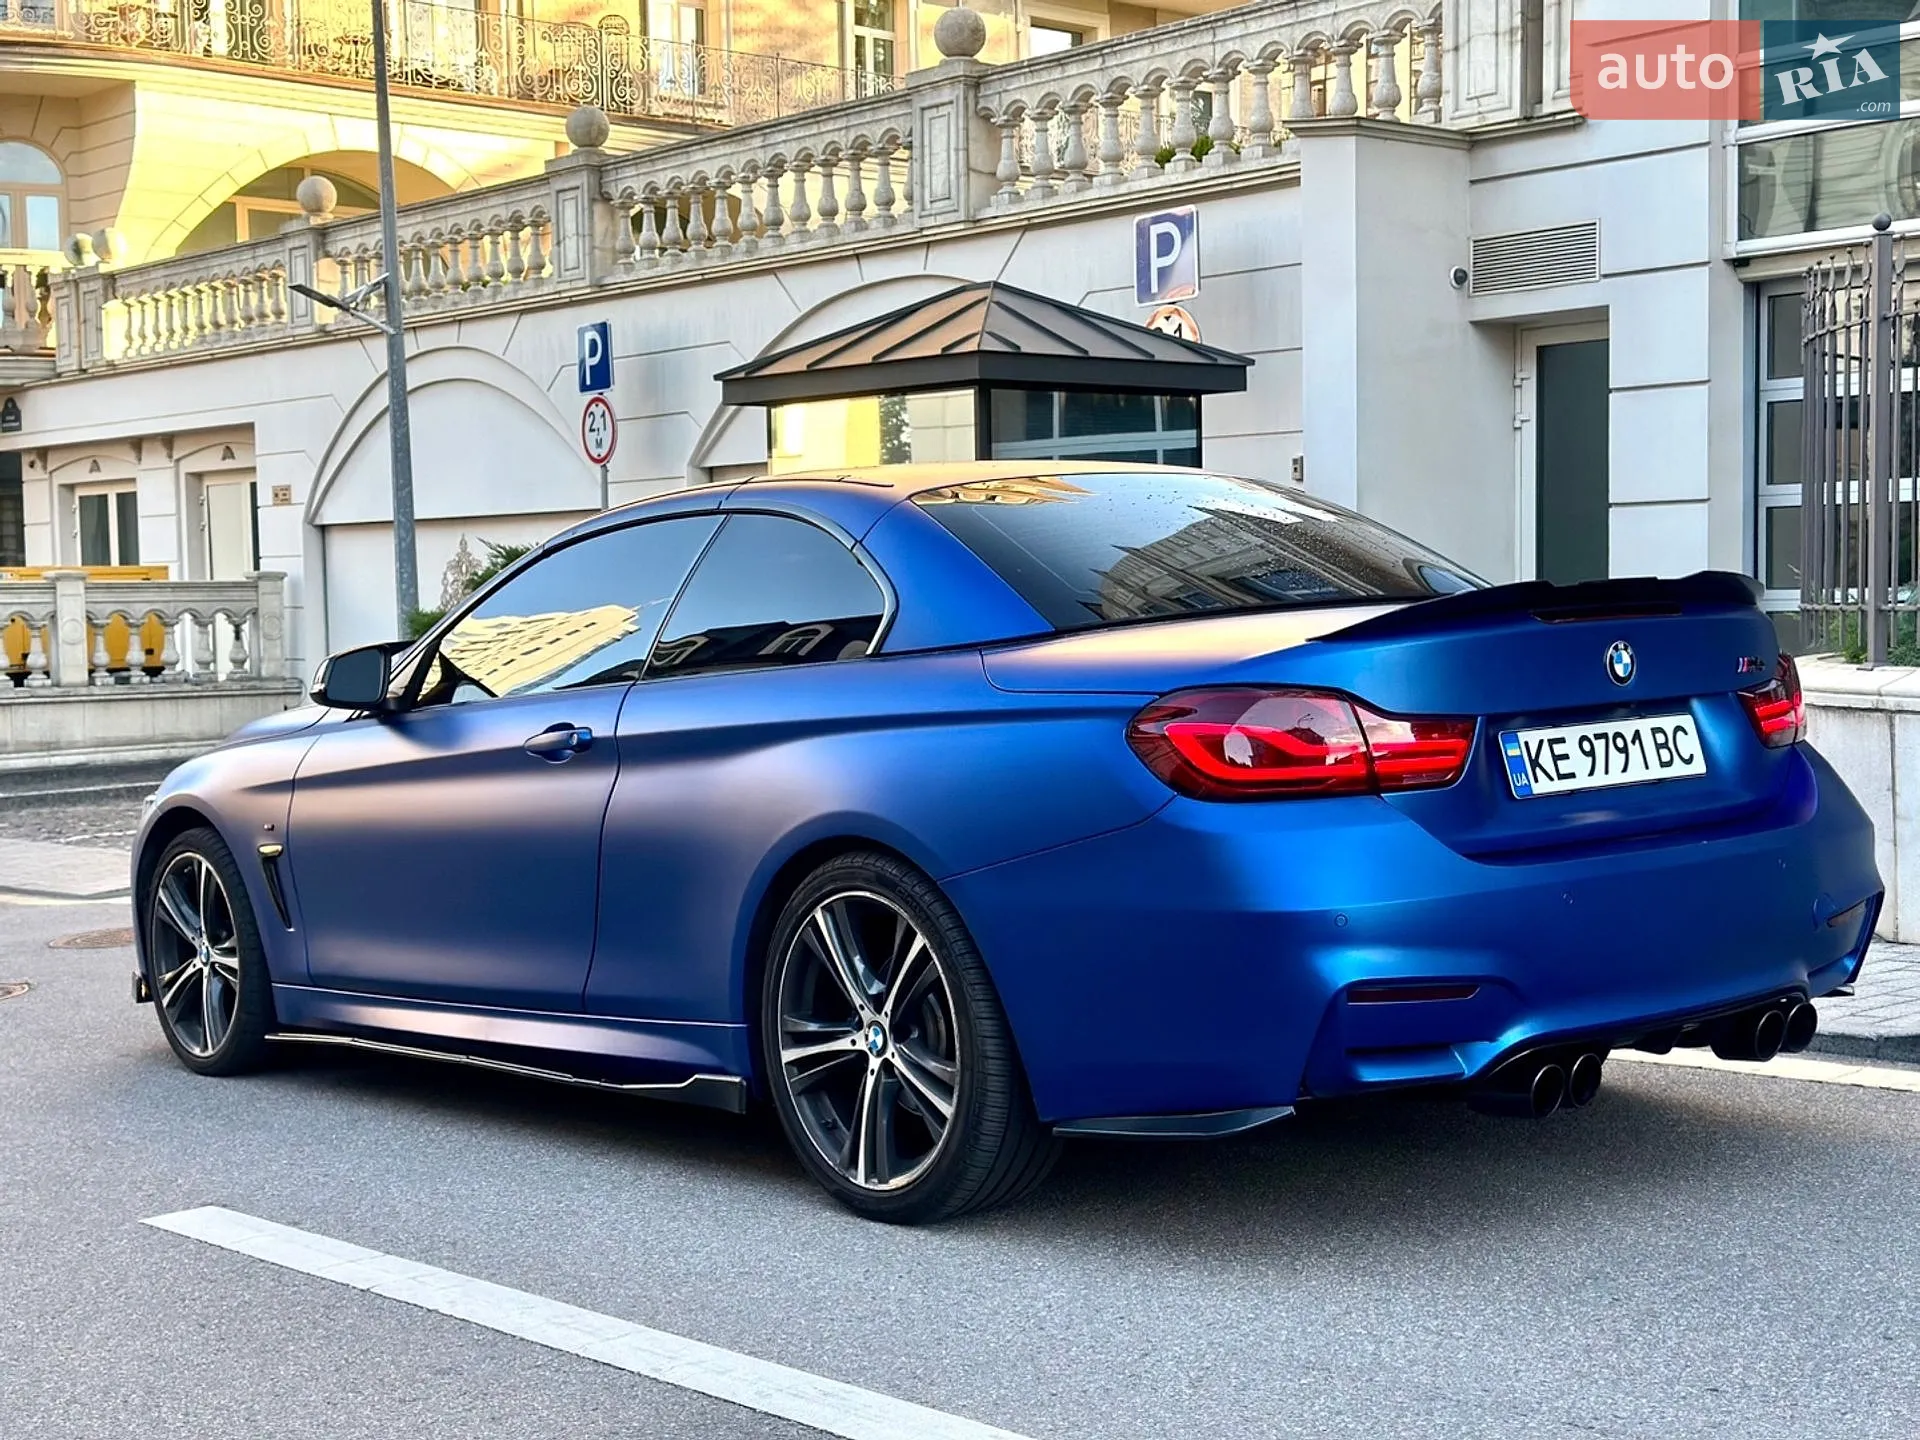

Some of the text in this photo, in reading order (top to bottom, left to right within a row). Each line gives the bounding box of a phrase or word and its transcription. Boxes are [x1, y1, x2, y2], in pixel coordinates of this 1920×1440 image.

[1149, 221, 1182, 295] P
[584, 330, 602, 386] P
[588, 409, 607, 436] 2,1
[1513, 773, 1529, 787] UA
[1524, 725, 1694, 784] KE 9791 BC
